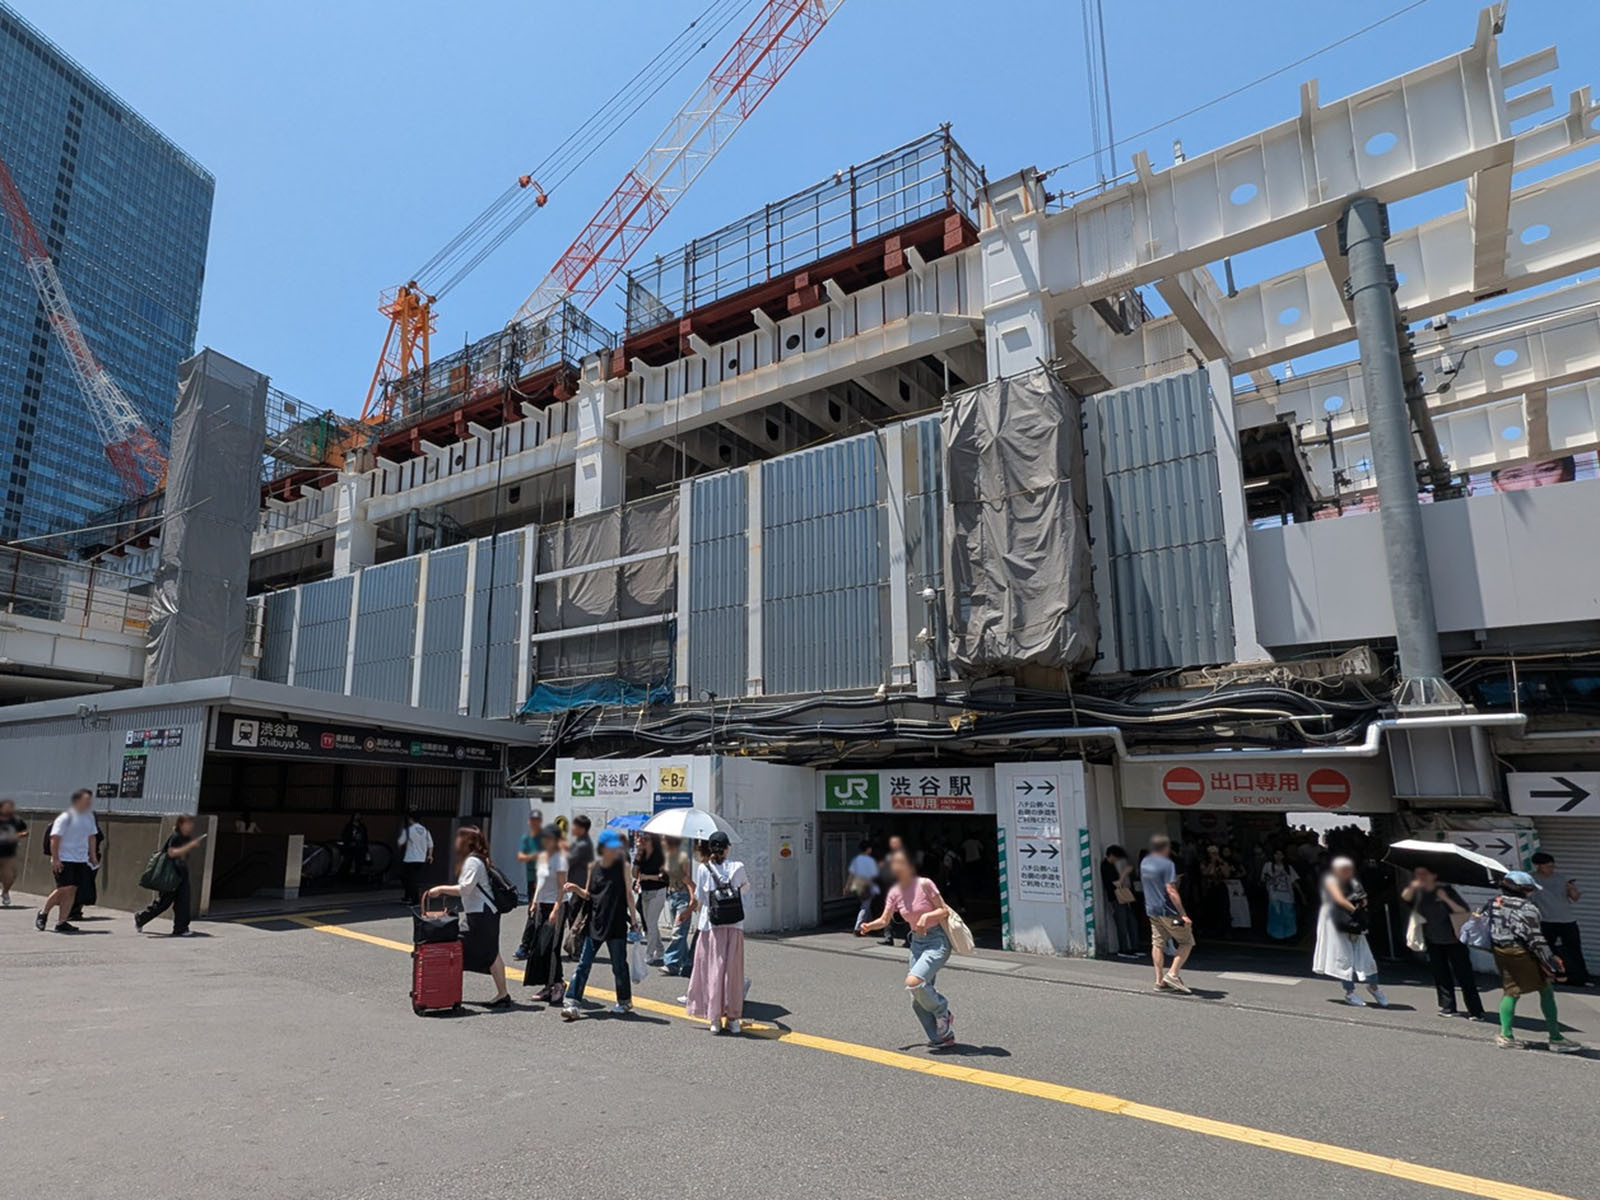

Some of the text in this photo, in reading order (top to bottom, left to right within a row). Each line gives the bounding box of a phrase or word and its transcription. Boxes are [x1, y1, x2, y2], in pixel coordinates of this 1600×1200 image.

[260, 722, 299, 738] 渋谷駅
[260, 737, 311, 750] Shibuya Sta.
[573, 773, 594, 789] JR
[598, 774, 630, 787] 渋谷駅
[671, 773, 686, 788] B7
[890, 776, 972, 796] 渋谷駅
[1211, 772, 1299, 792] 出口専用
[834, 778, 869, 799] JR
[893, 797, 937, 809] 入口専用
[1233, 796, 1282, 805] EXIT ONLY
